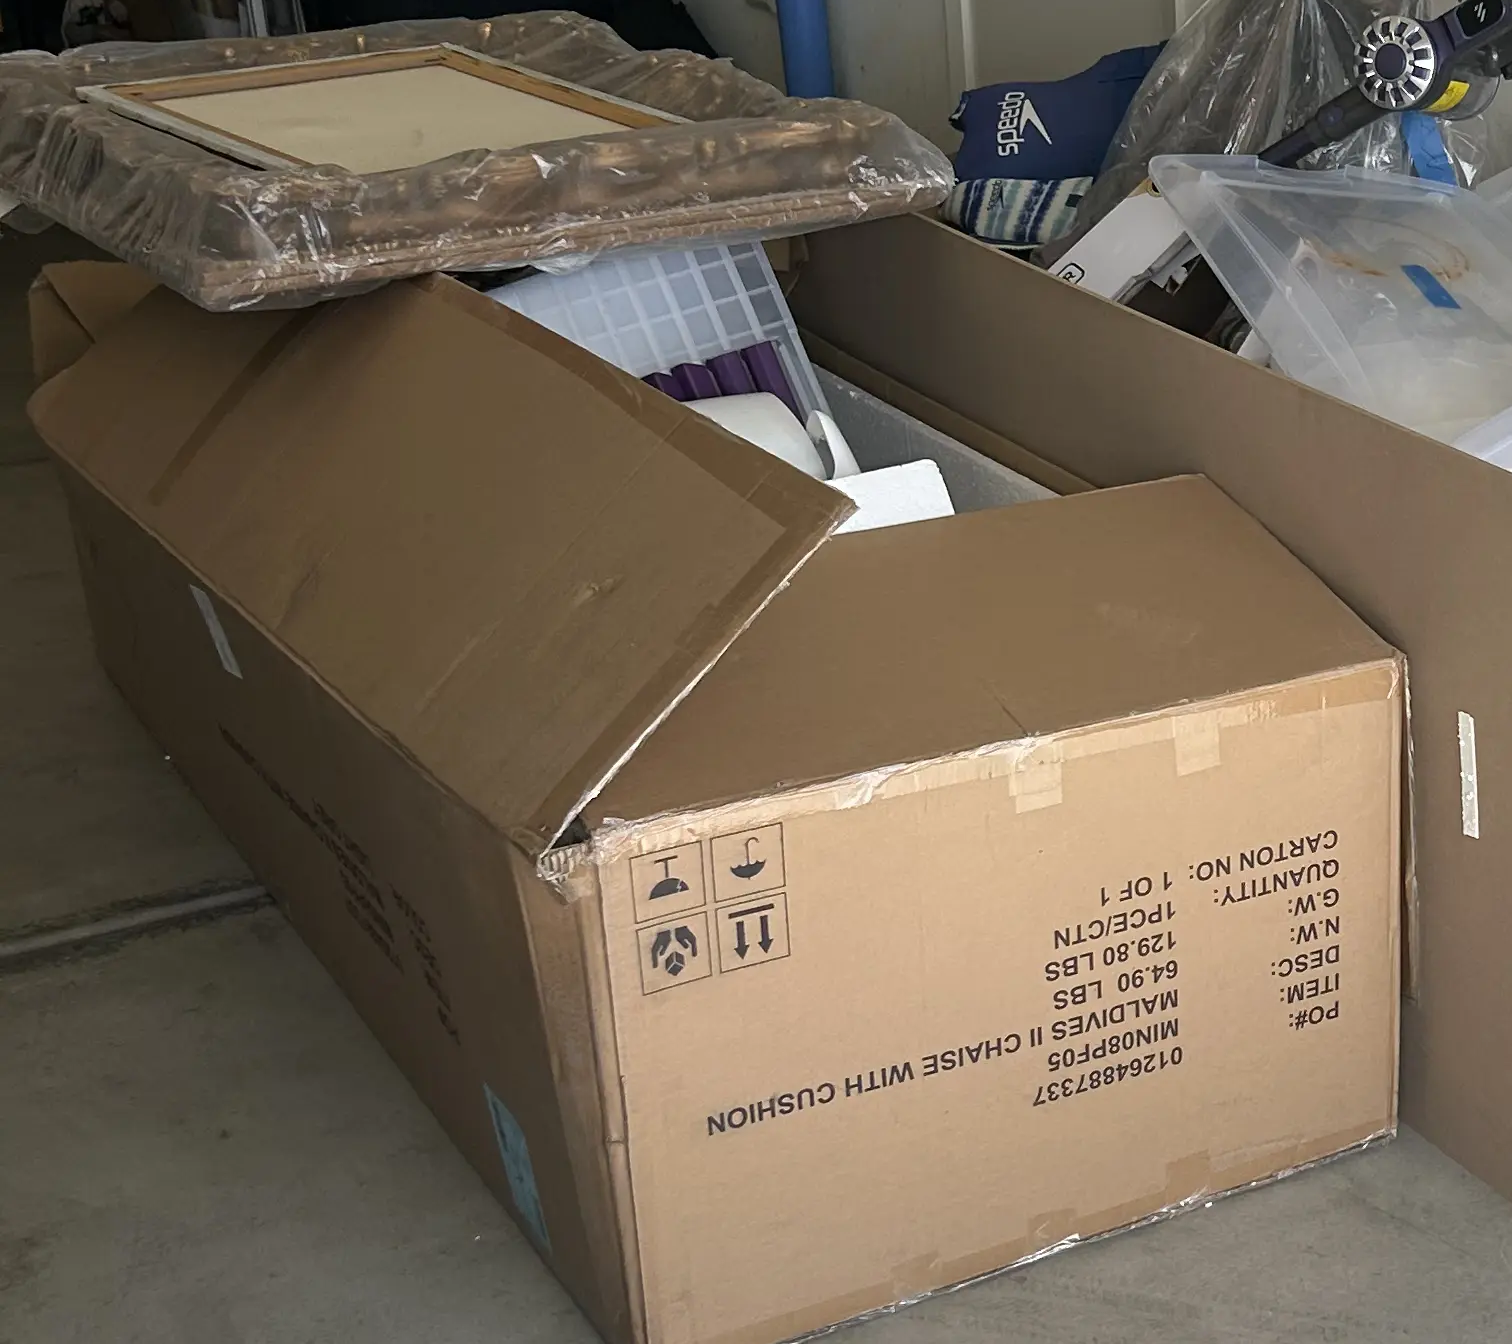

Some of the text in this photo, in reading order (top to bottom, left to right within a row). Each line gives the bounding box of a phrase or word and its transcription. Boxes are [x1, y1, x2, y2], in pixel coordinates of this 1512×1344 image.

[997, 91, 1026, 156] speedo
[1053, 858, 1340, 950] QUANTITY: 1PCE/CTN
[1100, 829, 1339, 907] CARTON NO: 1 OF 1
[1045, 887, 1340, 982] G.W: 129.80 LBS
[1053, 915, 1340, 1011] N.W: 64.90 LBS
[706, 944, 1340, 1137] DESC: MALDIVES II CHAISE WITH CUSHION
[1032, 1000, 1340, 1107] PO#: 01264887337
[1047, 972, 1340, 1072] ITEM: MIN08PF05
